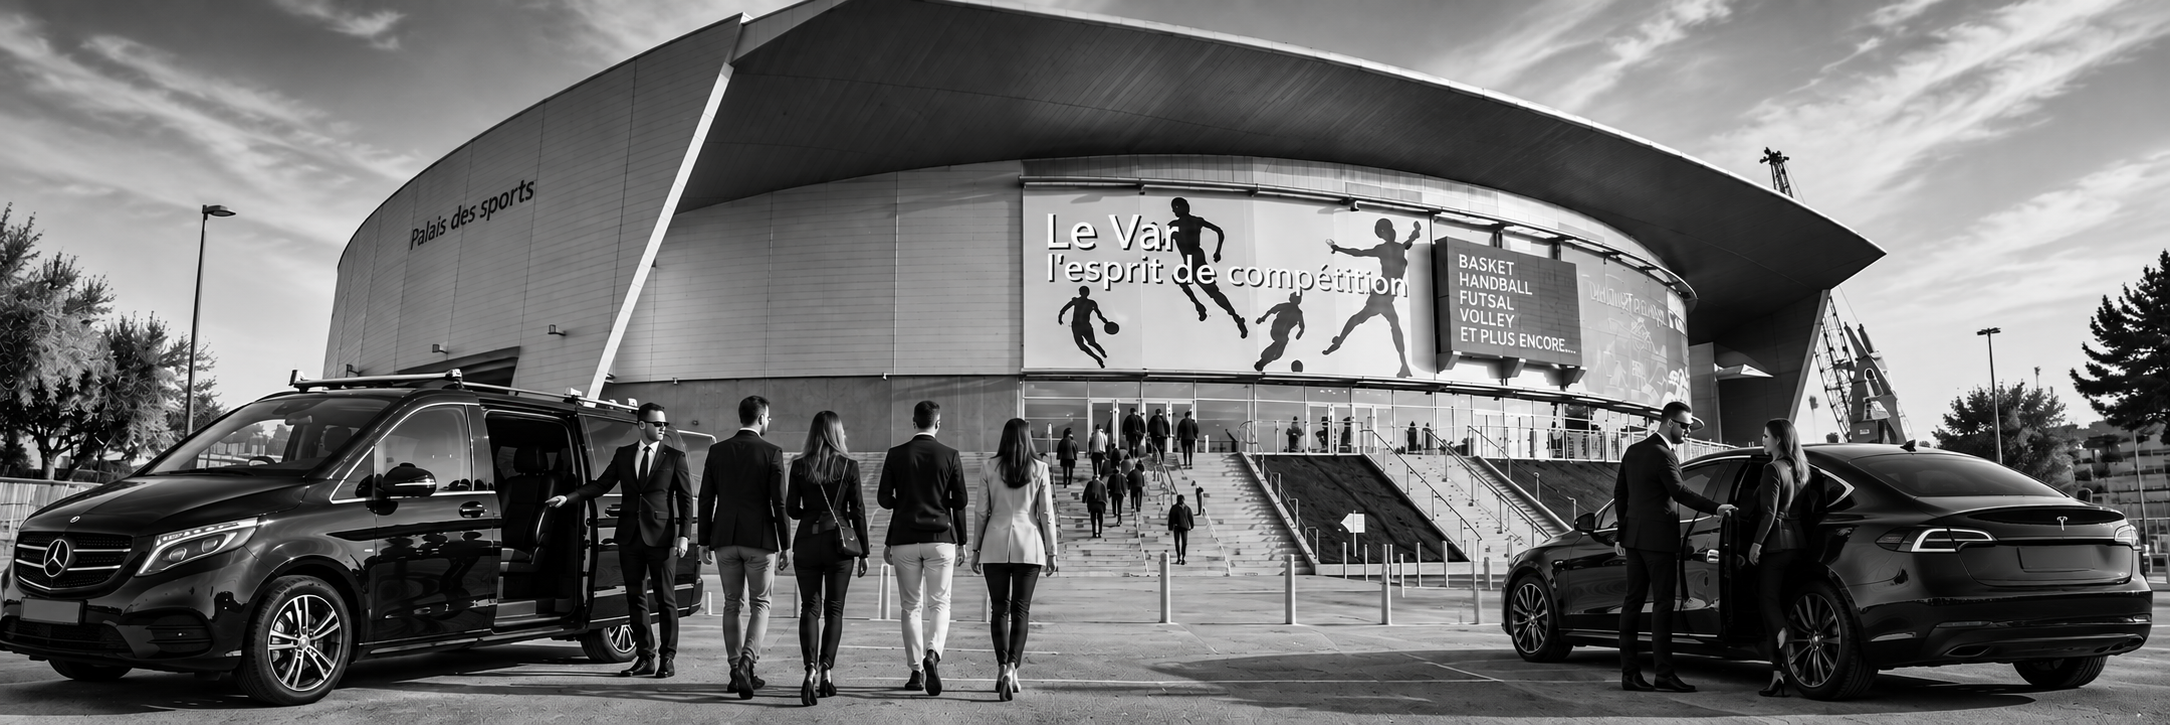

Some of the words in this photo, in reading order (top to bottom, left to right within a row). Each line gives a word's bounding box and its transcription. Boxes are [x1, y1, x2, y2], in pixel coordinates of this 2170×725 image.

[410, 215, 447, 250] Palais
[450, 205, 476, 230] des
[479, 179, 535, 221] sports
[1047, 213, 1098, 251] Le
[1108, 213, 1179, 252] Var
[1047, 252, 1164, 291] l'esprit
[1172, 254, 1217, 285] de
[1227, 264, 1408, 298] compétition
[1459, 253, 1515, 276] BASKET
[1459, 271, 1533, 296] HANDBALL
[1460, 289, 1515, 311] FUTSAL
[1460, 307, 1515, 329] VOLLEY
[1460, 326, 1478, 343] ET
[1480, 328, 1516, 347] PLUS
